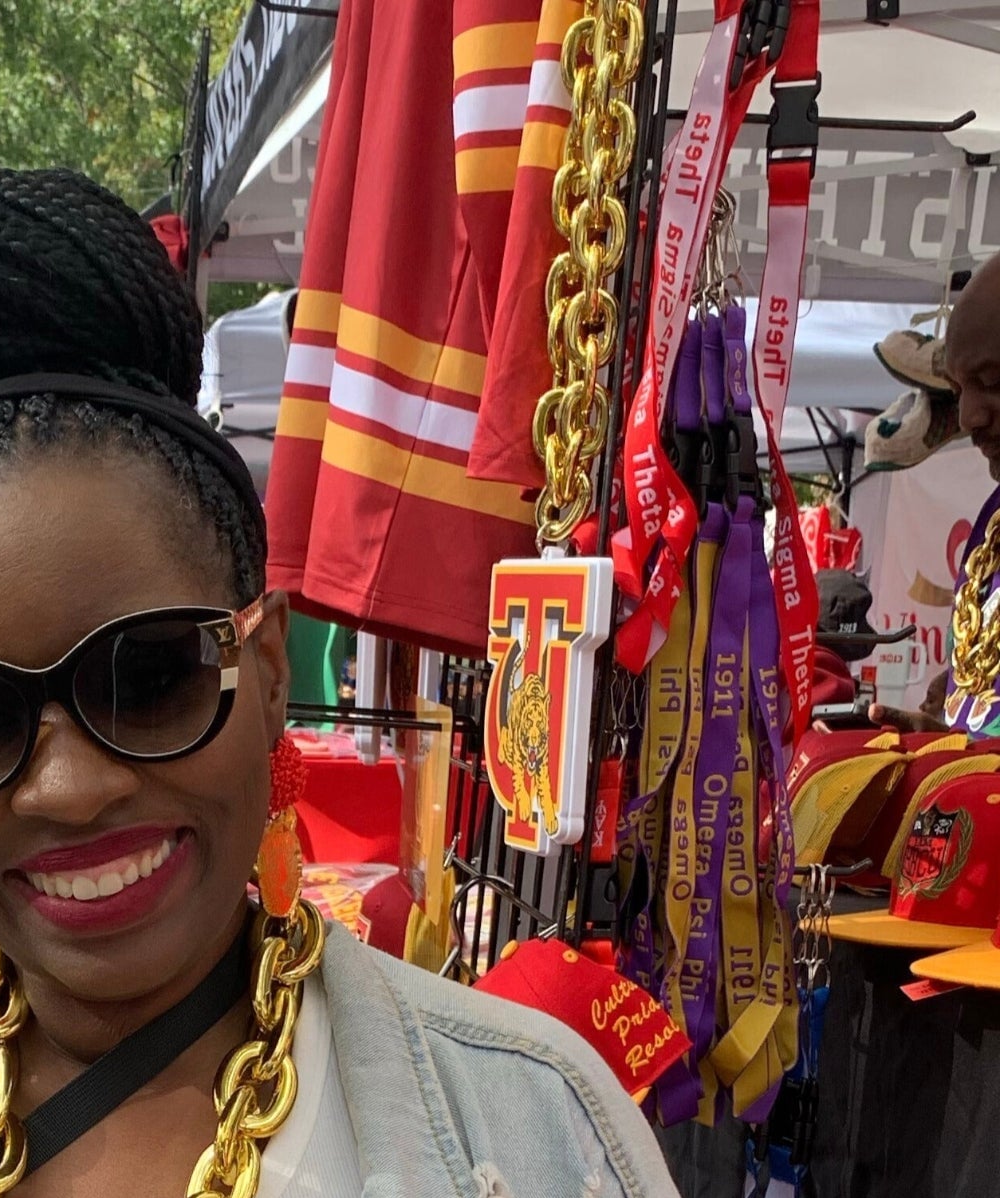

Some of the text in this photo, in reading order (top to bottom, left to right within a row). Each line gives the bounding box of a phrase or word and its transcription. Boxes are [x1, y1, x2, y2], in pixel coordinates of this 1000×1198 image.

[630, 443, 666, 539] Theta
[774, 515, 814, 711] Sigma Theta
[680, 652, 736, 1002] 1911 Omega Psi Phi
